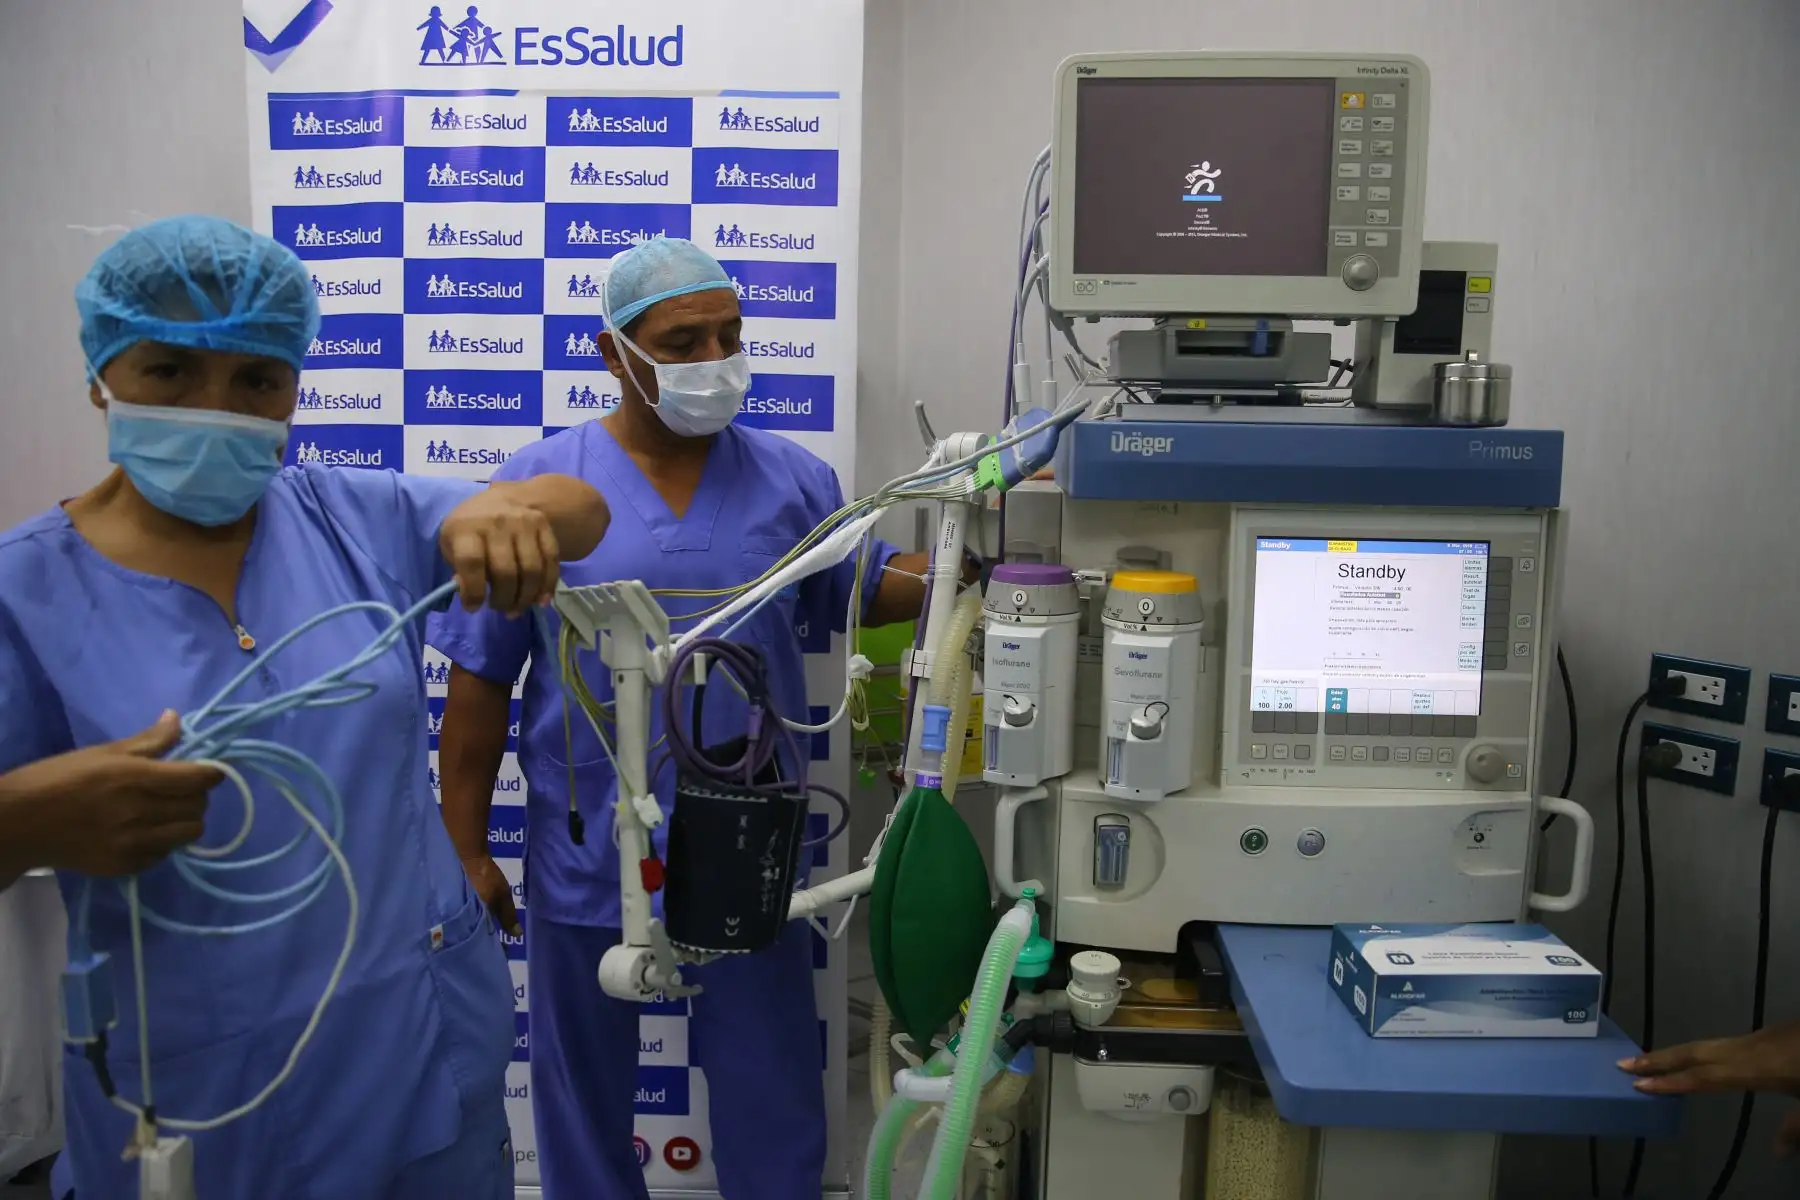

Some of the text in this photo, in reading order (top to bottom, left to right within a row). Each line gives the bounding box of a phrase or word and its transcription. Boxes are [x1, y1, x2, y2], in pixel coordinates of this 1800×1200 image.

[514, 24, 684, 67] EsSalud
[1380, 66, 1399, 75] Delta
[325, 116, 382, 136] EsSalud
[464, 114, 527, 132] EsSalud
[603, 116, 668, 134] EsSalud
[754, 116, 820, 134] EsSalud
[326, 170, 382, 188] EsSalud
[460, 170, 524, 187] EsSalud
[605, 170, 669, 187] EsSalud
[750, 173, 816, 190] EsSalud
[326, 228, 381, 246] EsSalud
[458, 229, 523, 247] EsSalud
[750, 232, 815, 250] EsSalud
[327, 279, 381, 296] EsSalud
[459, 281, 522, 299] EsSalud
[748, 285, 814, 303] EsSalud
[325, 338, 381, 355] EsSalud
[460, 337, 524, 354] EsSalud
[748, 341, 814, 358] EsSalud
[325, 393, 381, 410] EsSalud
[458, 393, 521, 410] EsSalud
[746, 398, 812, 415] EsSalud
[1111, 430, 1174, 456] Dräger
[1469, 440, 1533, 460] Primus
[323, 449, 382, 465] EsSalud
[459, 448, 512, 464] EsSalu
[1260, 541, 1291, 551] Standby
[1338, 563, 1406, 582] Standby
[992, 657, 1031, 668] Isoflurane
[1114, 667, 1163, 679] Sevoflurane
[1391, 955, 1407, 964] M
[1568, 1010, 1586, 1018] 100
